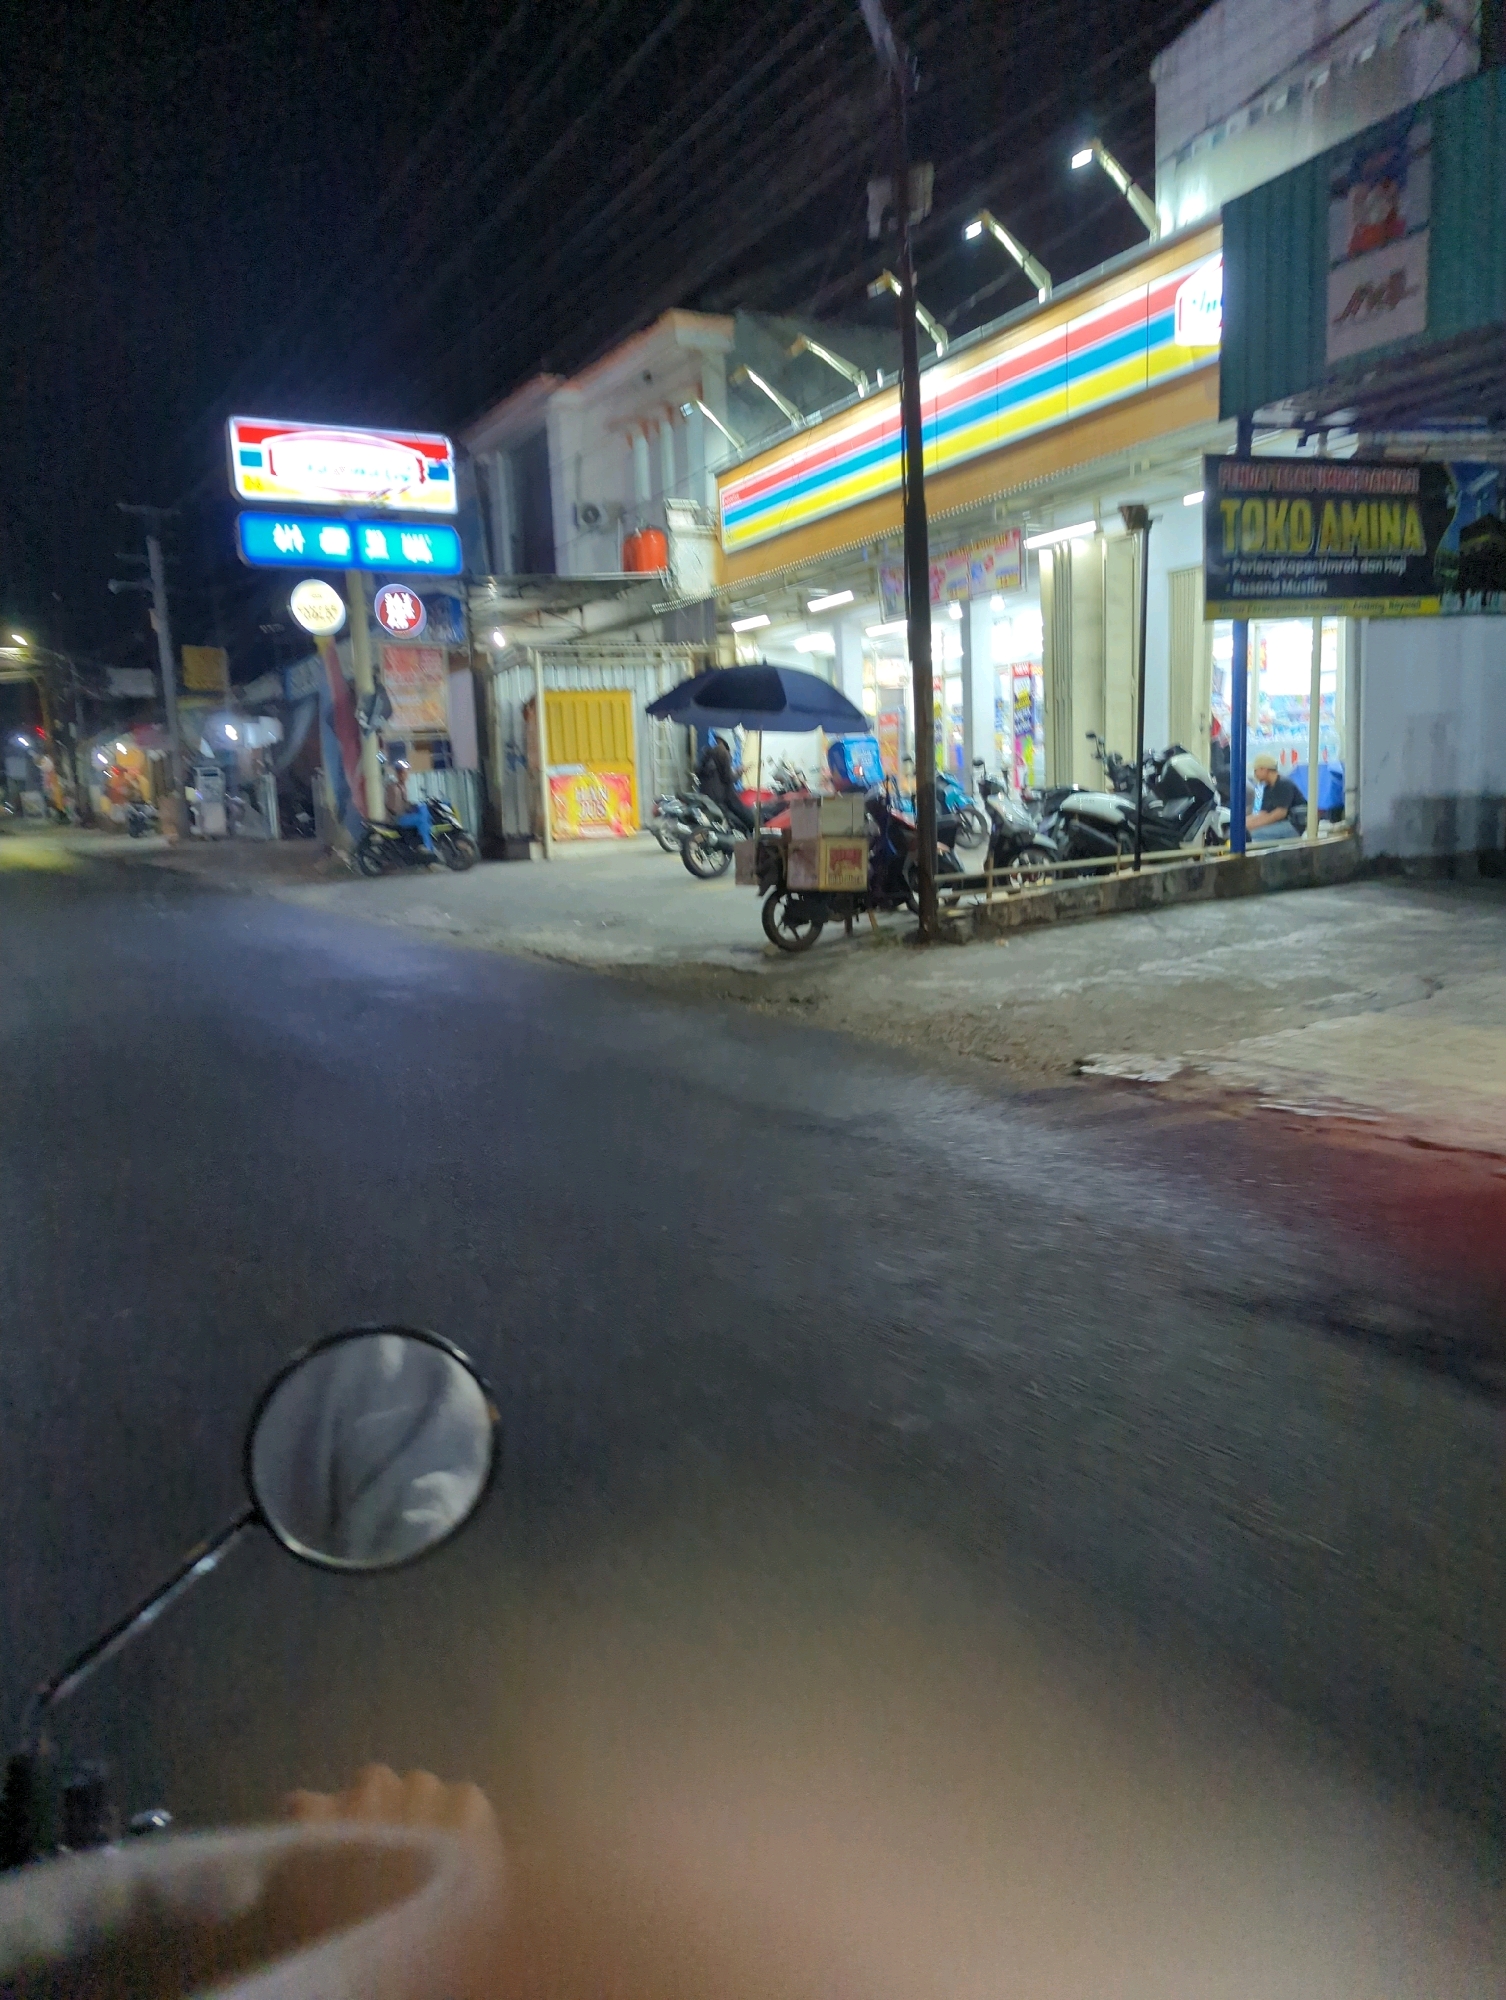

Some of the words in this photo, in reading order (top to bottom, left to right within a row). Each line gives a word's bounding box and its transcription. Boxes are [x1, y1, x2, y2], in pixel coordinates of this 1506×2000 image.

[1219, 497, 1313, 554] TOKO
[1317, 499, 1425, 556] AMINA
[1360, 558, 1382, 574] dan
[1383, 555, 1407, 577] Haji
[1232, 579, 1280, 597] Busana
[1281, 576, 1328, 596] Muslim
